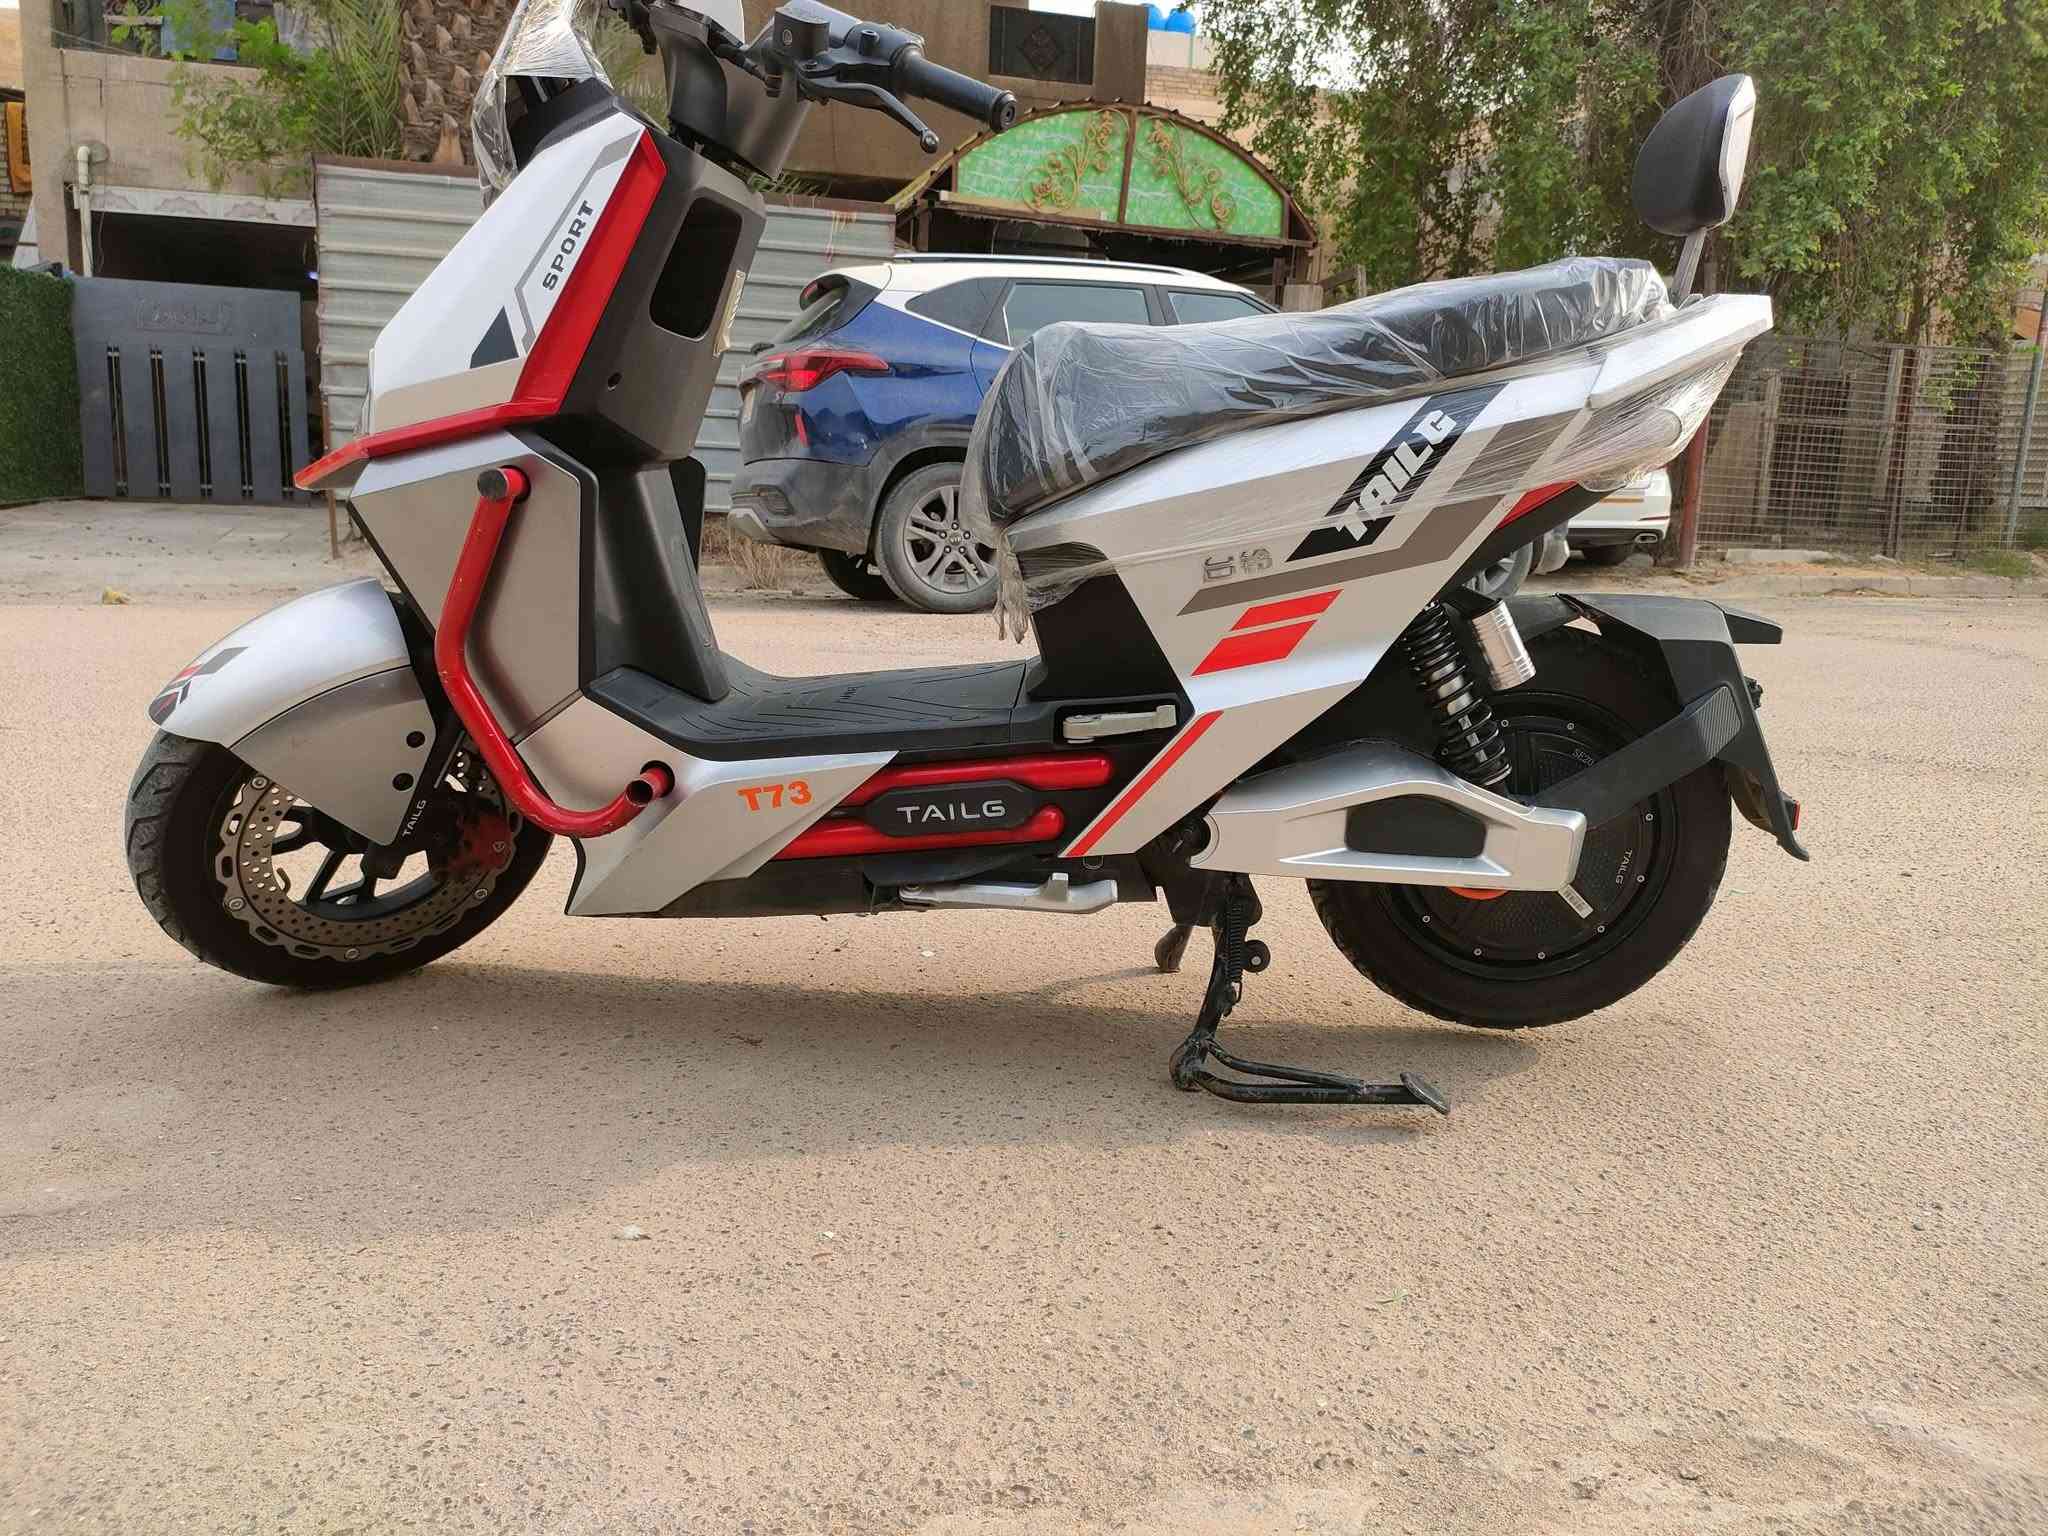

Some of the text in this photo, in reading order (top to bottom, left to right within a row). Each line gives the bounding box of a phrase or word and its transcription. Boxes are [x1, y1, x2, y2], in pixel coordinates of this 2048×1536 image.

[542, 200, 593, 290] SPORT
[1335, 409, 1457, 542] TAILG
[737, 780, 813, 811] T73
[896, 800, 1006, 824] TAILG
[402, 800, 427, 837] TAILG
[1615, 849, 1633, 884] TAILG
